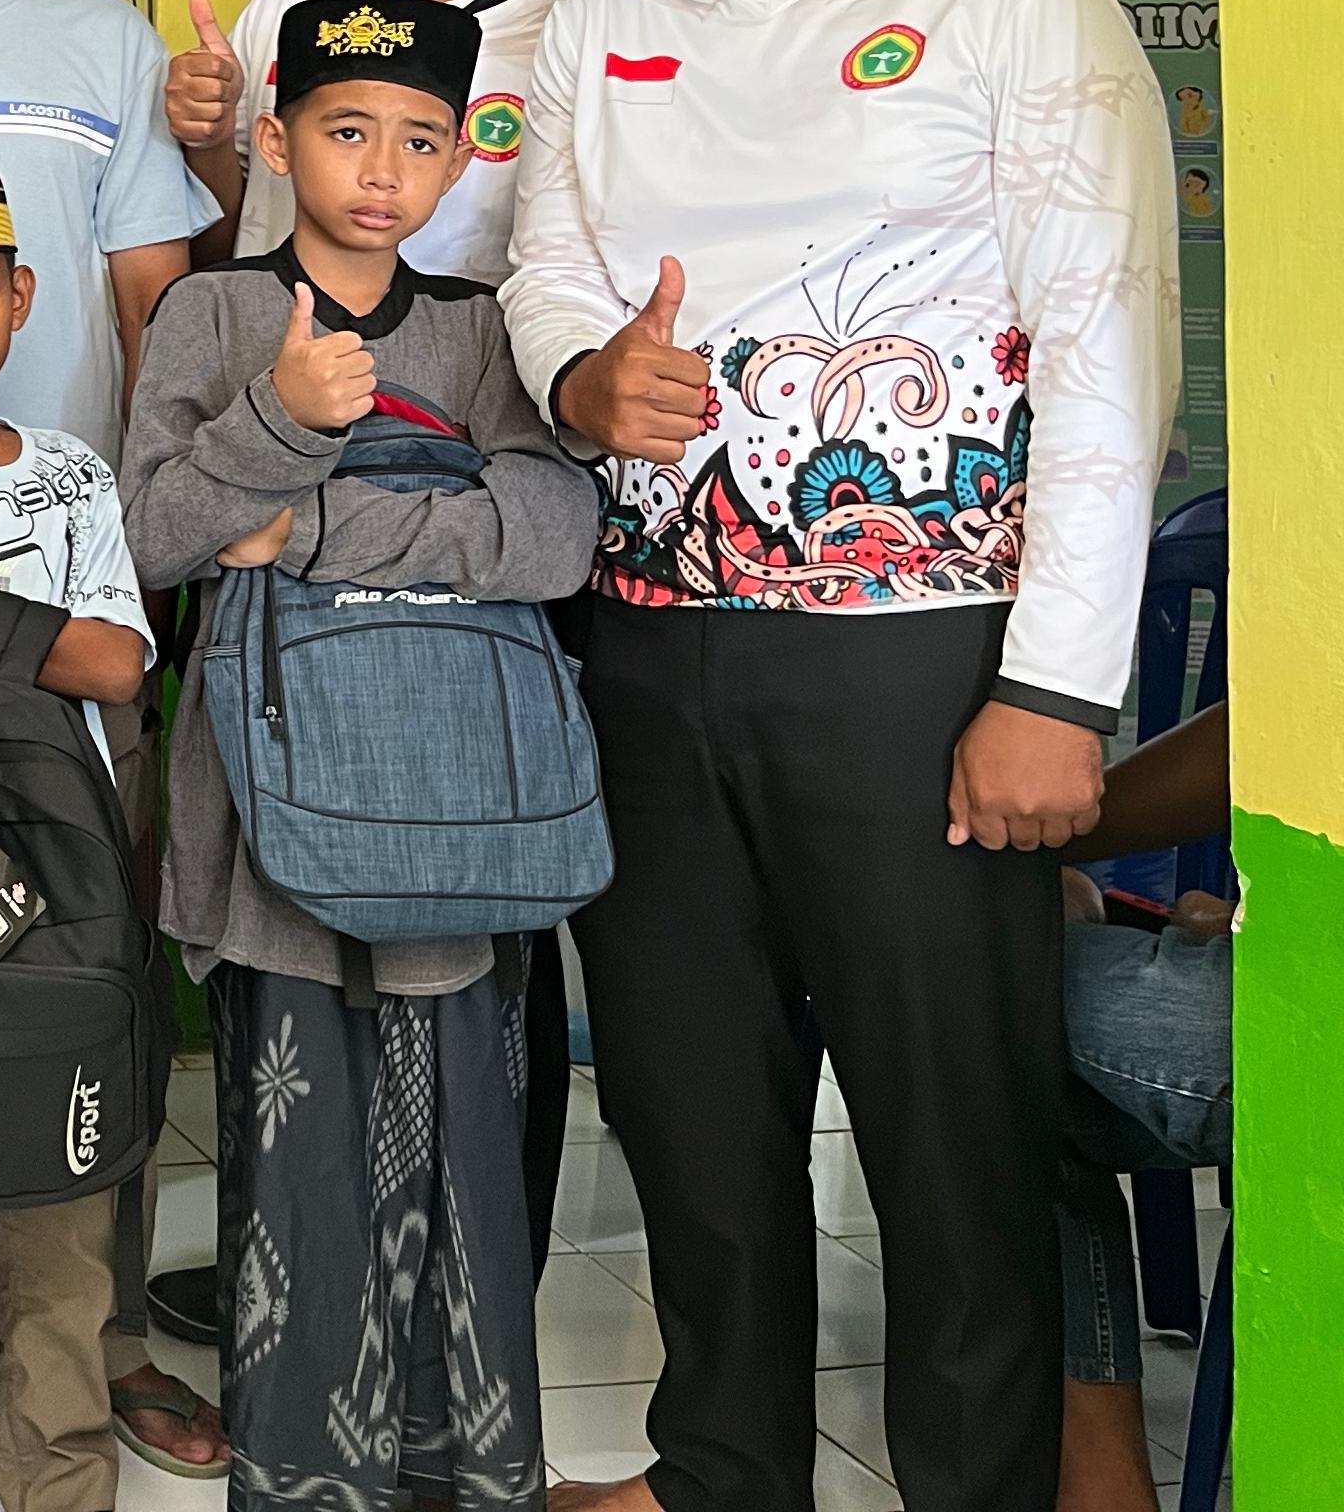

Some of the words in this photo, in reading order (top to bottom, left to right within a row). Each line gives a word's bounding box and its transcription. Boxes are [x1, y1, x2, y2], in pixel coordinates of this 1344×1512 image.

[379, 42, 395, 57] U
[9, 103, 71, 121] LACOSTE
[77, 1080, 101, 1160] sport
